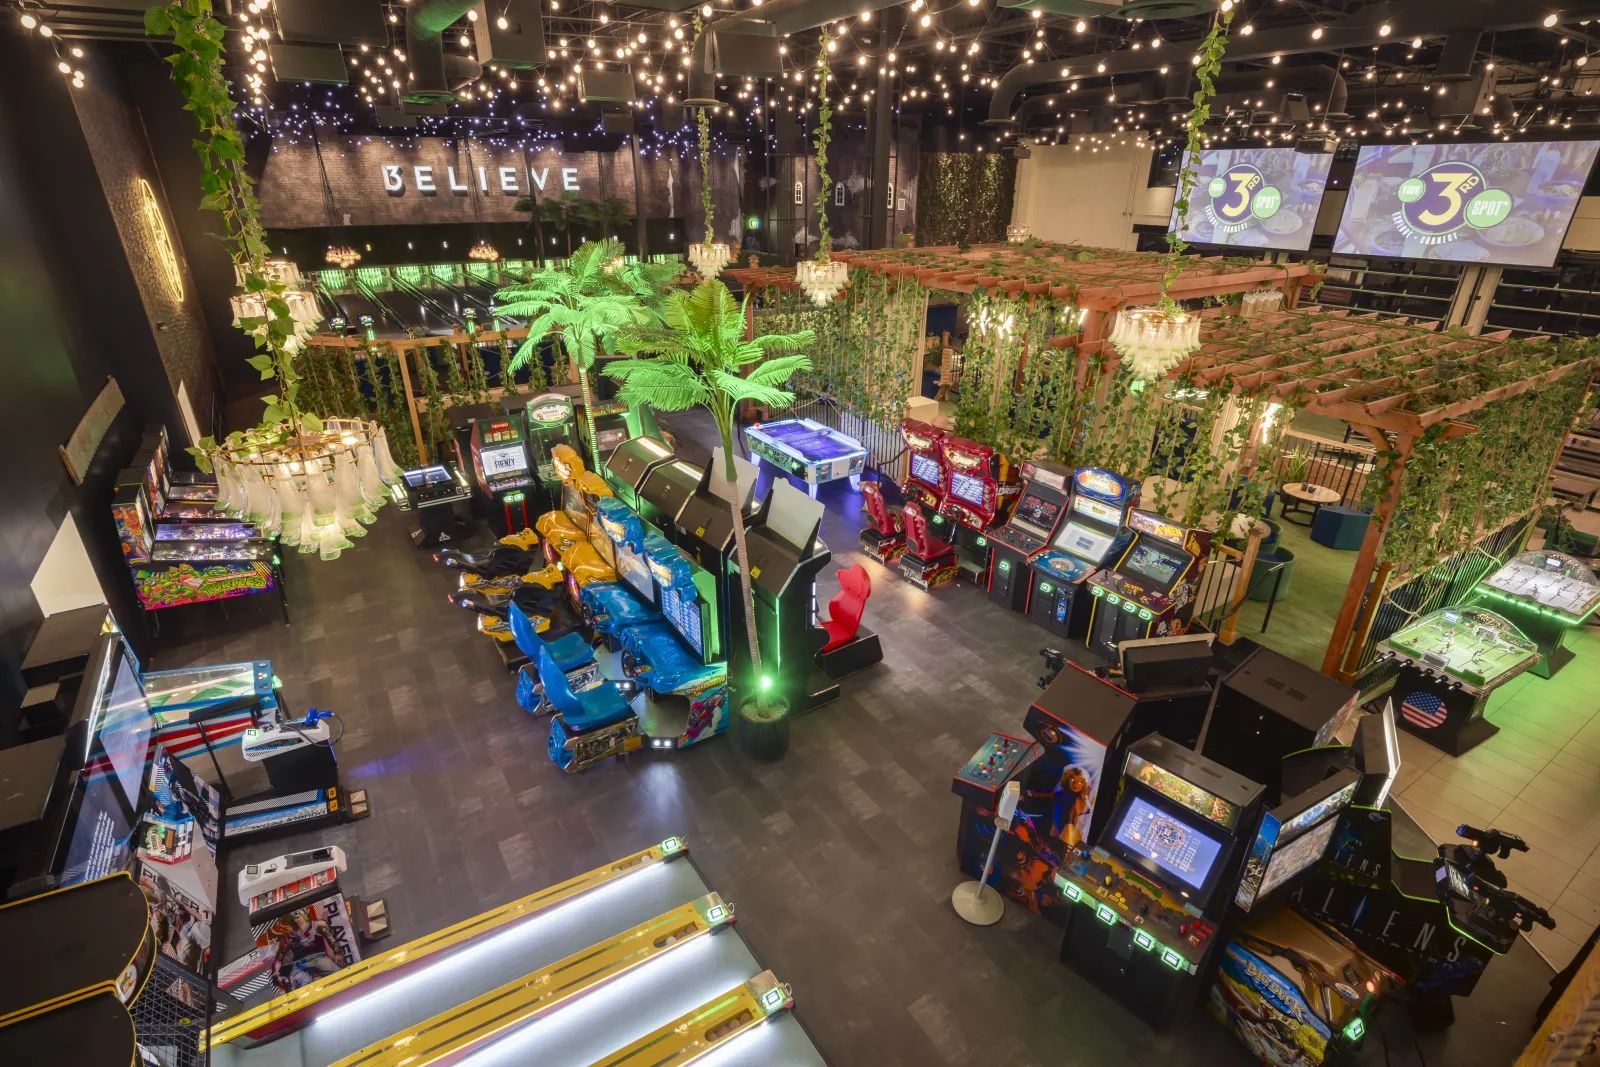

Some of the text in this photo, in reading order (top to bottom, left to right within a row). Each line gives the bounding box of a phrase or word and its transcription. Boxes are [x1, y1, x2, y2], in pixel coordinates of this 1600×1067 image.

[381, 165, 580, 191] BELIEVE
[1402, 185, 1421, 195] YOUR
[1255, 196, 1279, 209] SPOT
[1471, 200, 1508, 216] SPOT
[1391, 211, 1458, 245] EXPLORE CONNECT
[494, 458, 515, 468] FRENZY
[997, 487, 1021, 496] DRIFT
[1154, 524, 1183, 537] X-MEN
[200, 576, 266, 596] TURTLES
[1334, 850, 1381, 876] IENS
[142, 867, 200, 914] PLYER
[324, 901, 355, 966] PLAYER
[1246, 960, 1270, 987] BIG
[1270, 981, 1304, 1022] BUCK
